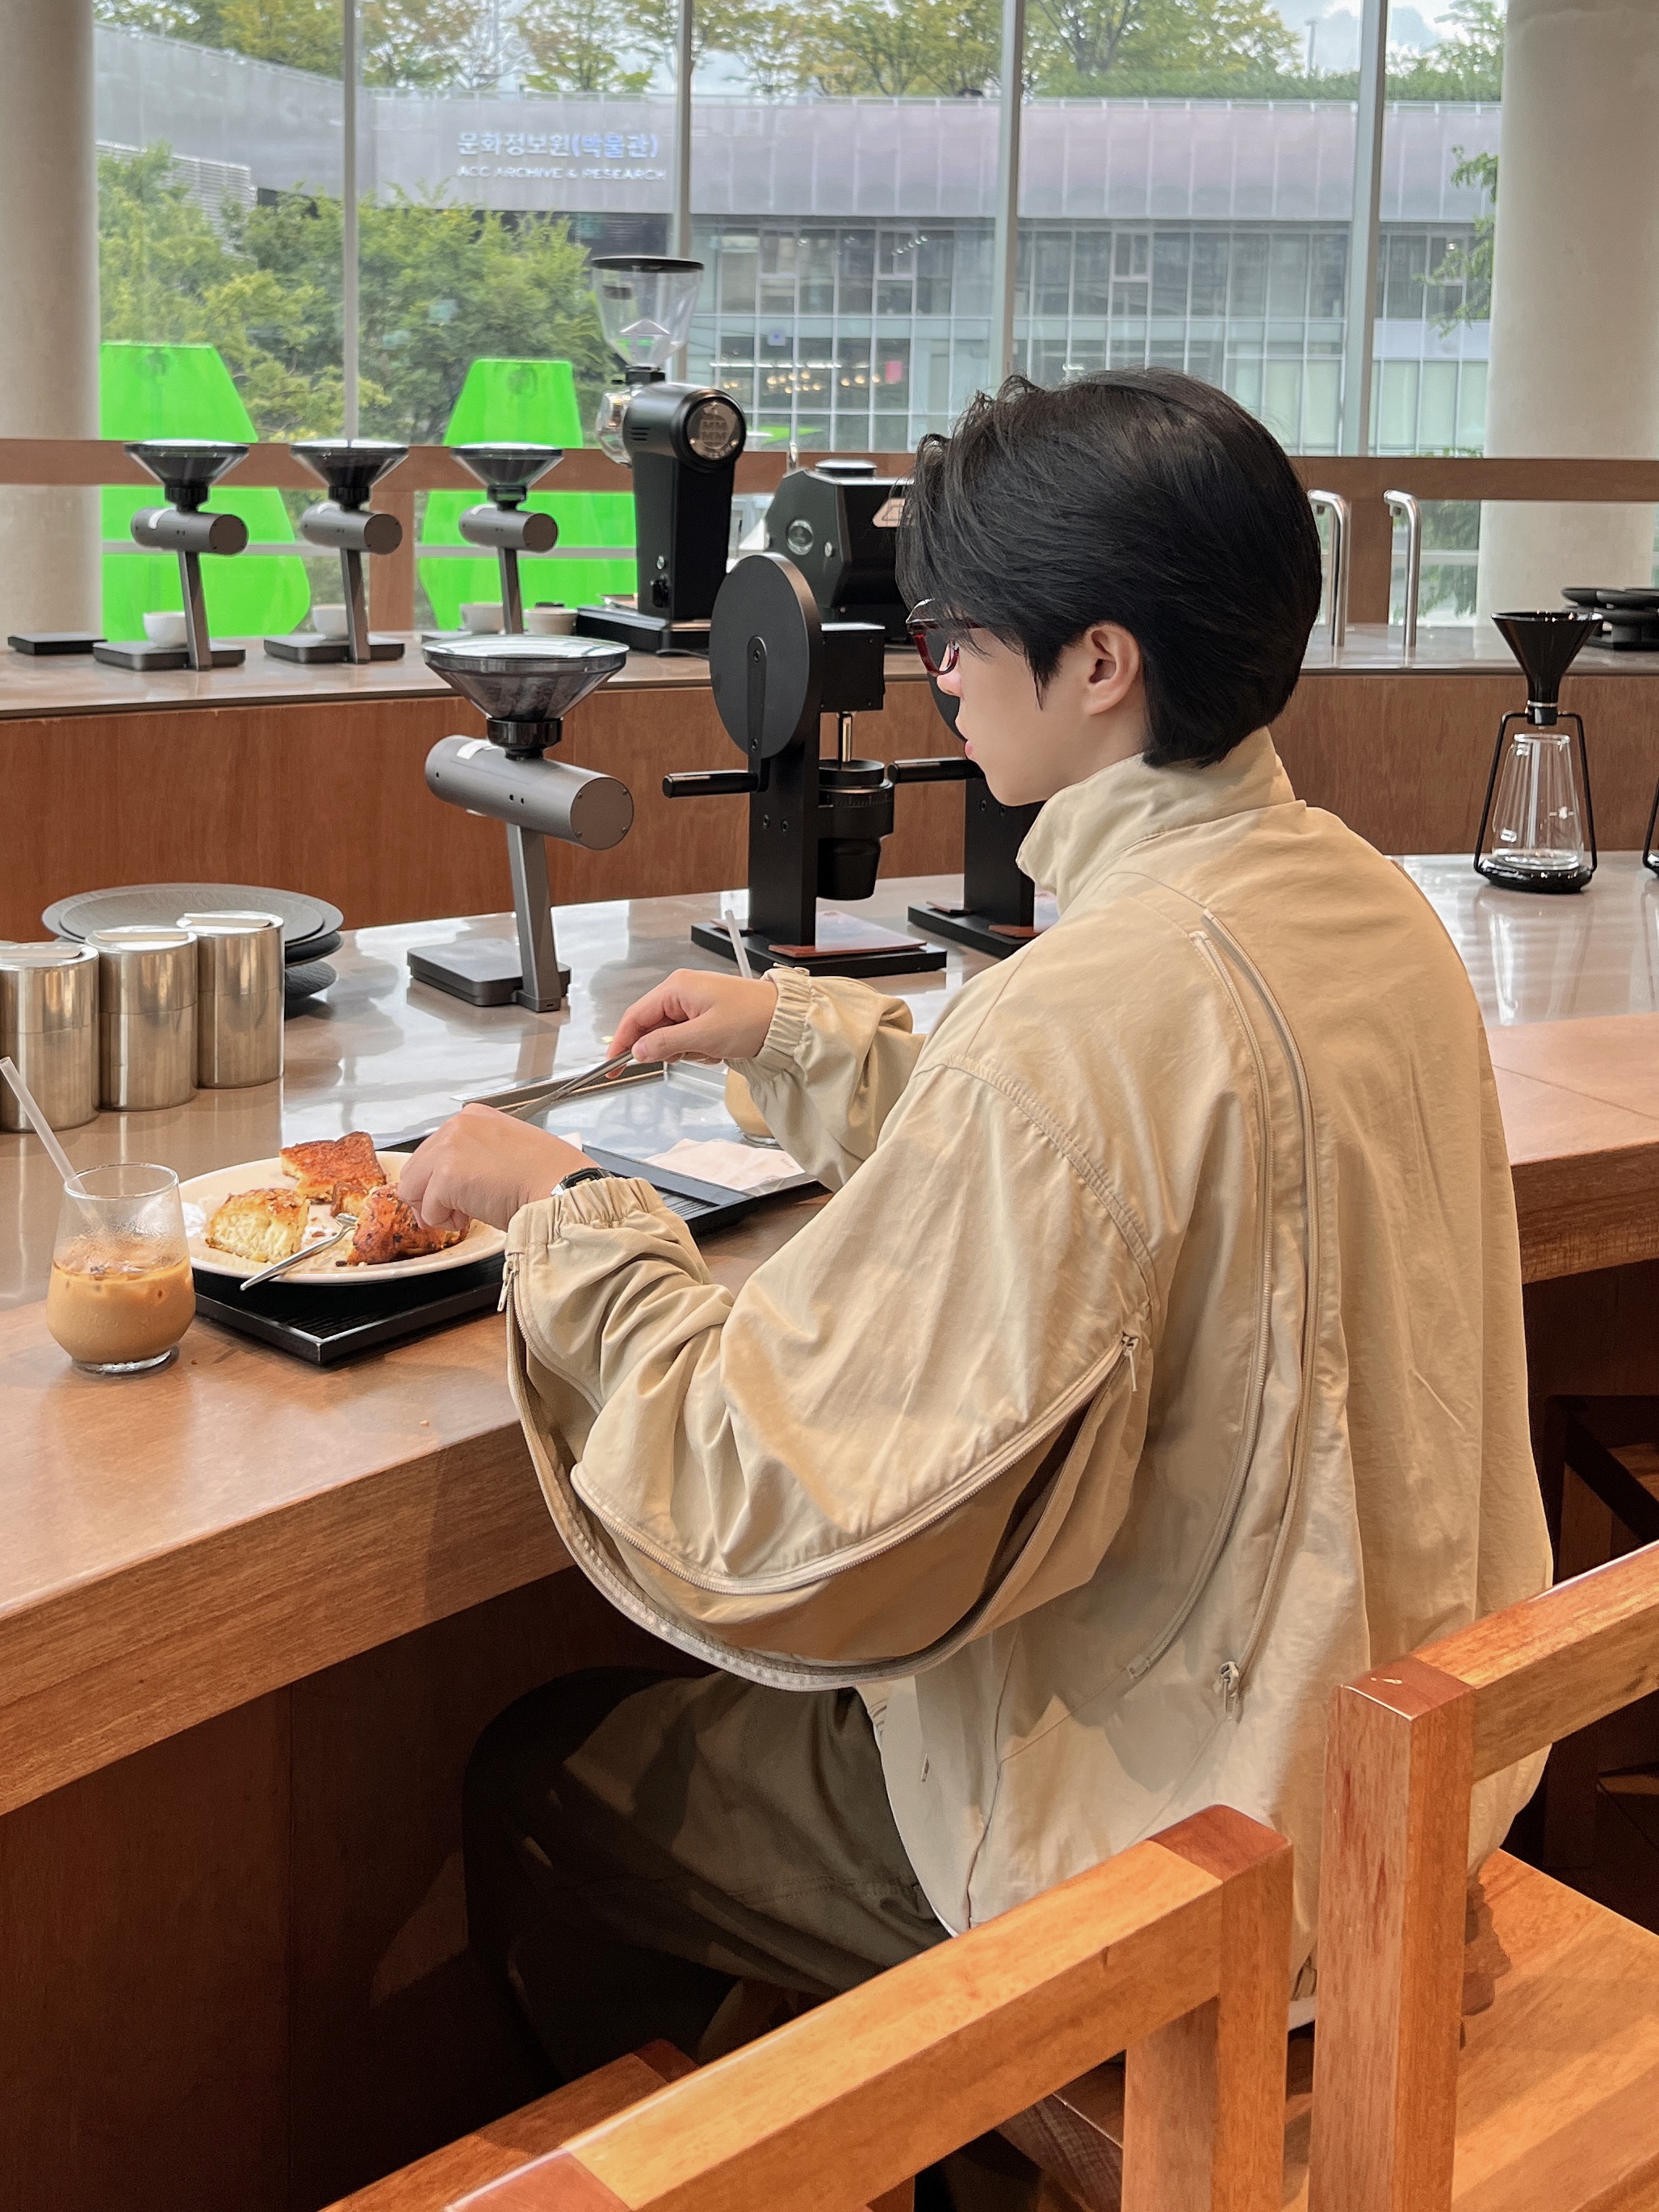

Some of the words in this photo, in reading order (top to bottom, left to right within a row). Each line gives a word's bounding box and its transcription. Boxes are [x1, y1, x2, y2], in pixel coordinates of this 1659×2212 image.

[457, 132, 659, 159] 문화정보원(박물관)
[457, 165, 491, 178] ACC
[493, 166, 563, 179] ARCHIVE
[581, 168, 667, 181] RESEARCH
